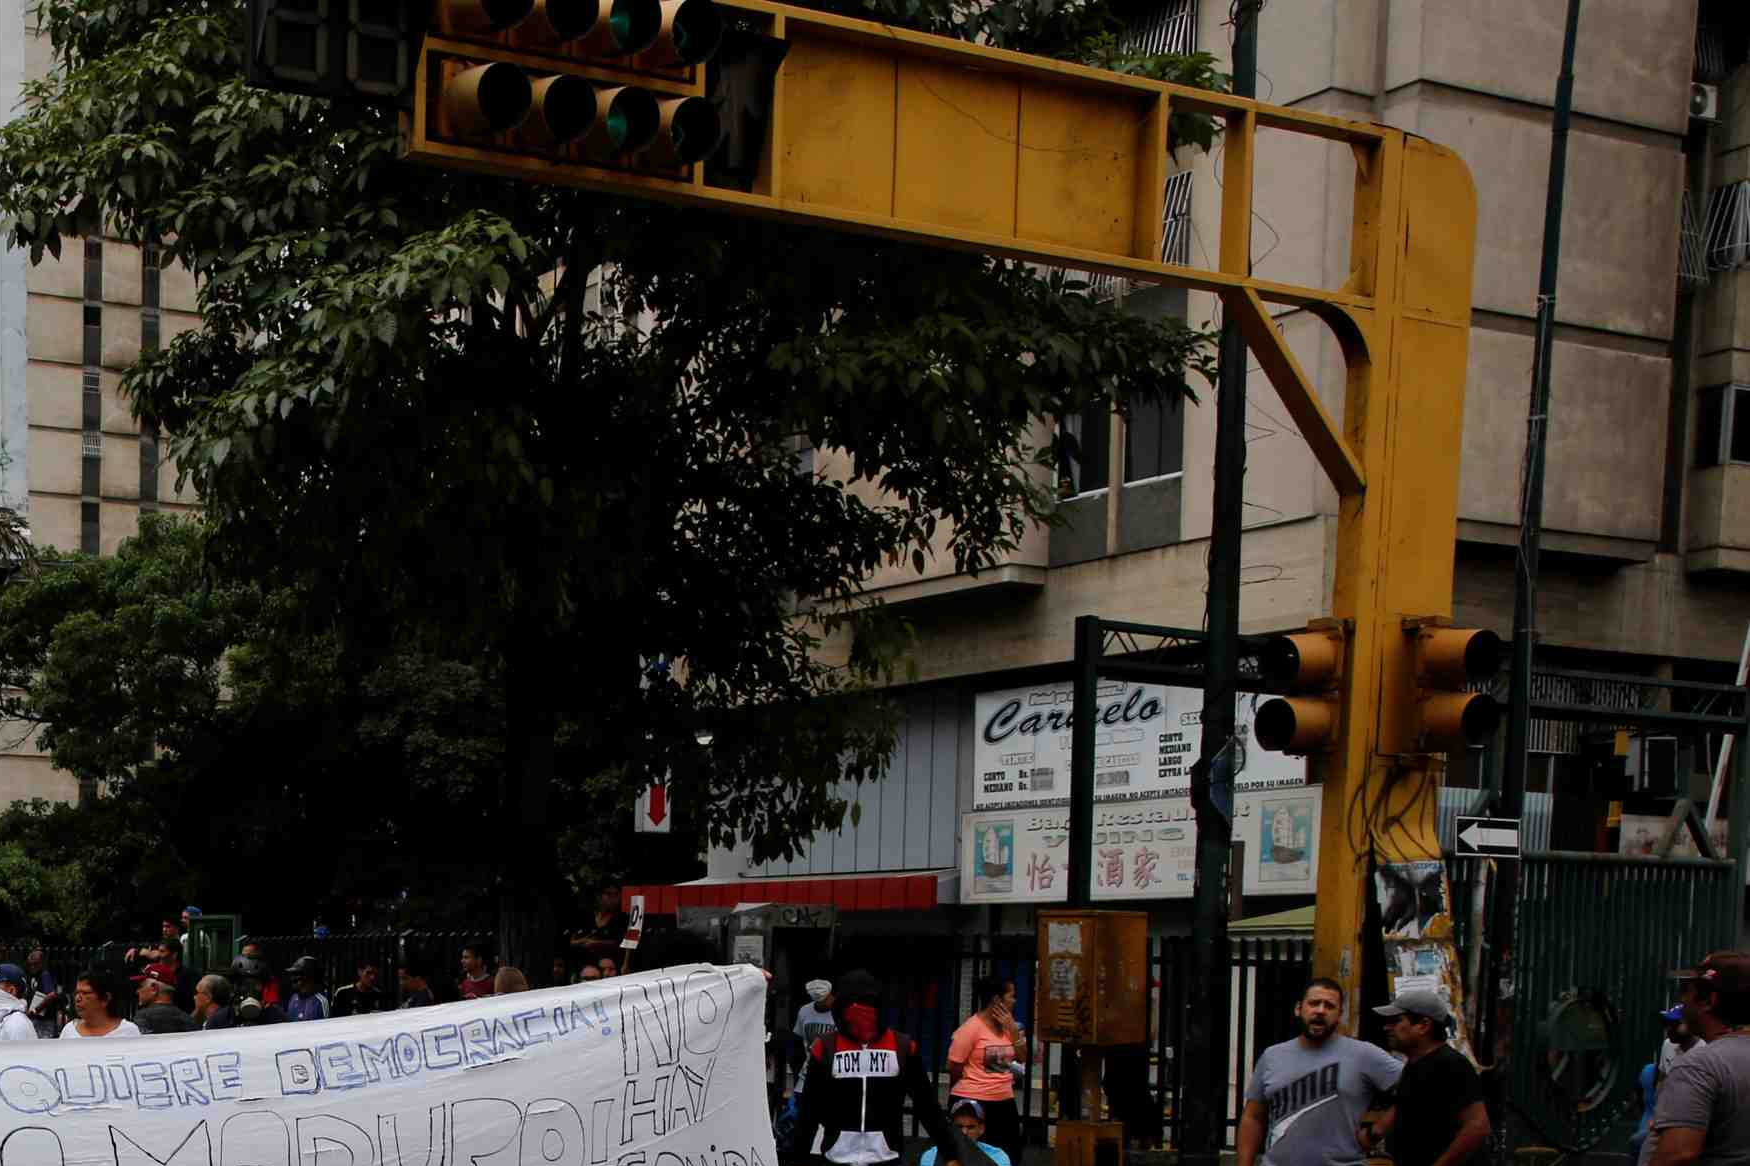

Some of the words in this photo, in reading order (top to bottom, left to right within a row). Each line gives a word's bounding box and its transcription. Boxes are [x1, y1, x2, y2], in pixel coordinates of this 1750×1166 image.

[274, 999, 612, 1096] DEMOCRACIA!
[619, 969, 735, 1077] NO
[619, 1056, 718, 1146] HAY
